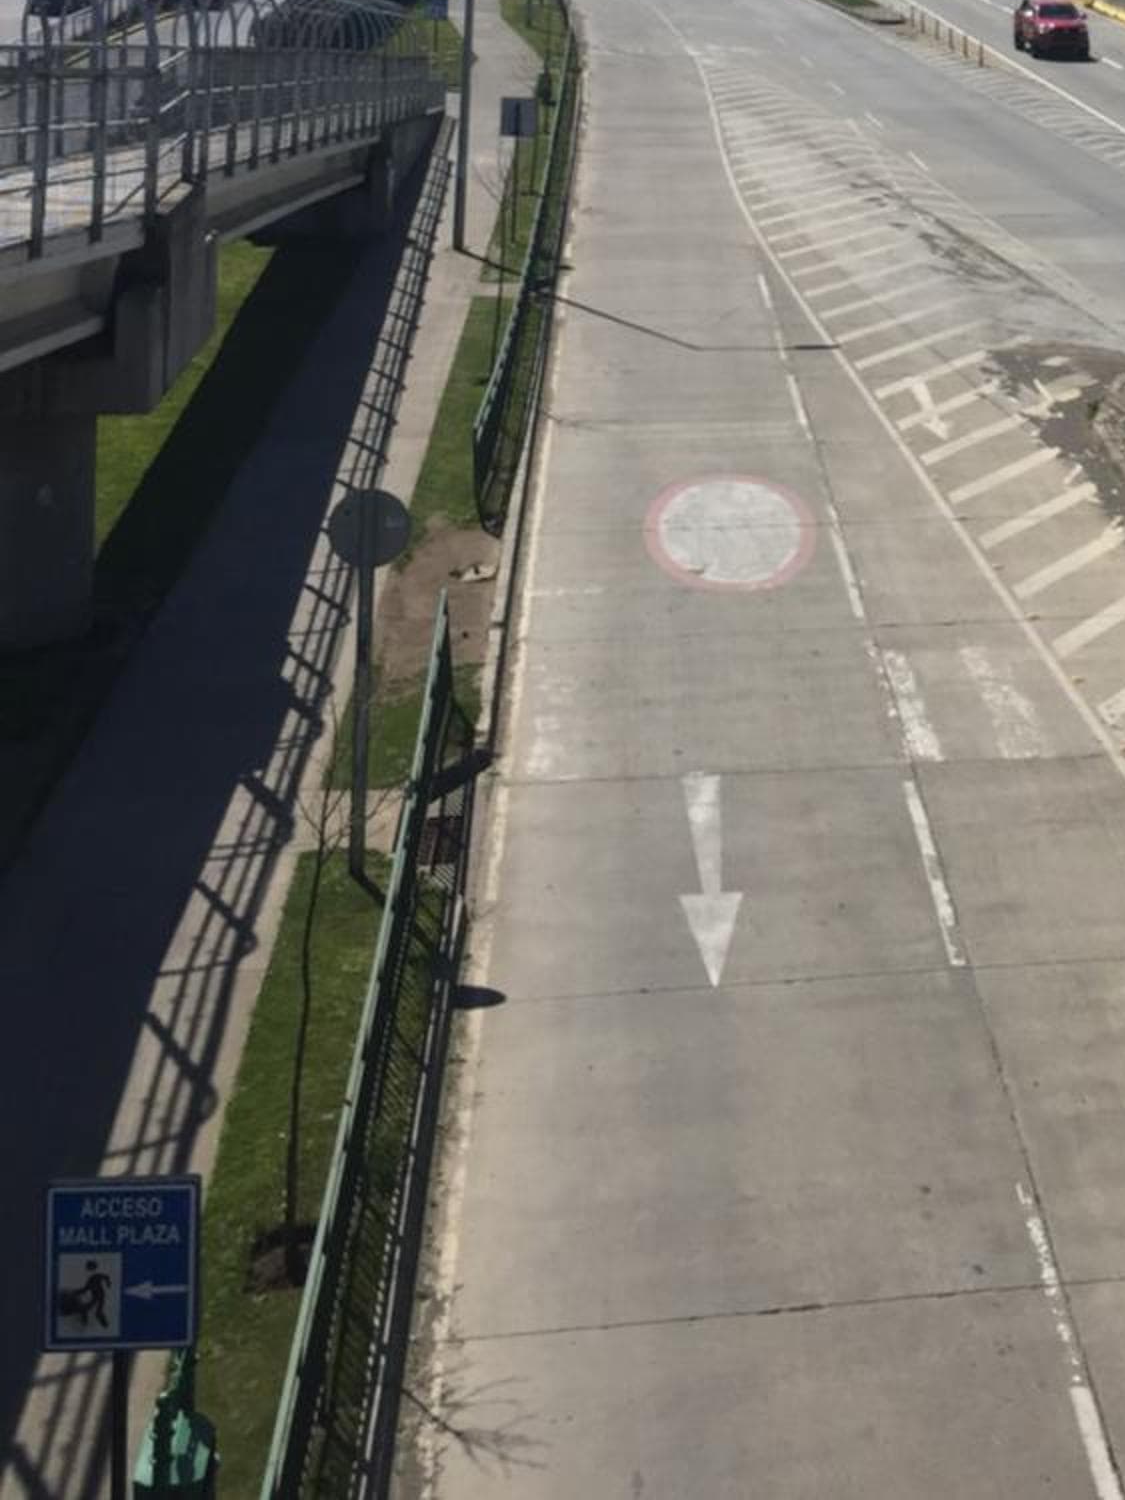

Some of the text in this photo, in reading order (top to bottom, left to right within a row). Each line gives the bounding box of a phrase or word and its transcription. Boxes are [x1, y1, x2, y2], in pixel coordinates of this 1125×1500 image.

[80, 1198, 163, 1219] ACCESO
[59, 1224, 180, 1245] MALL PLAZA
